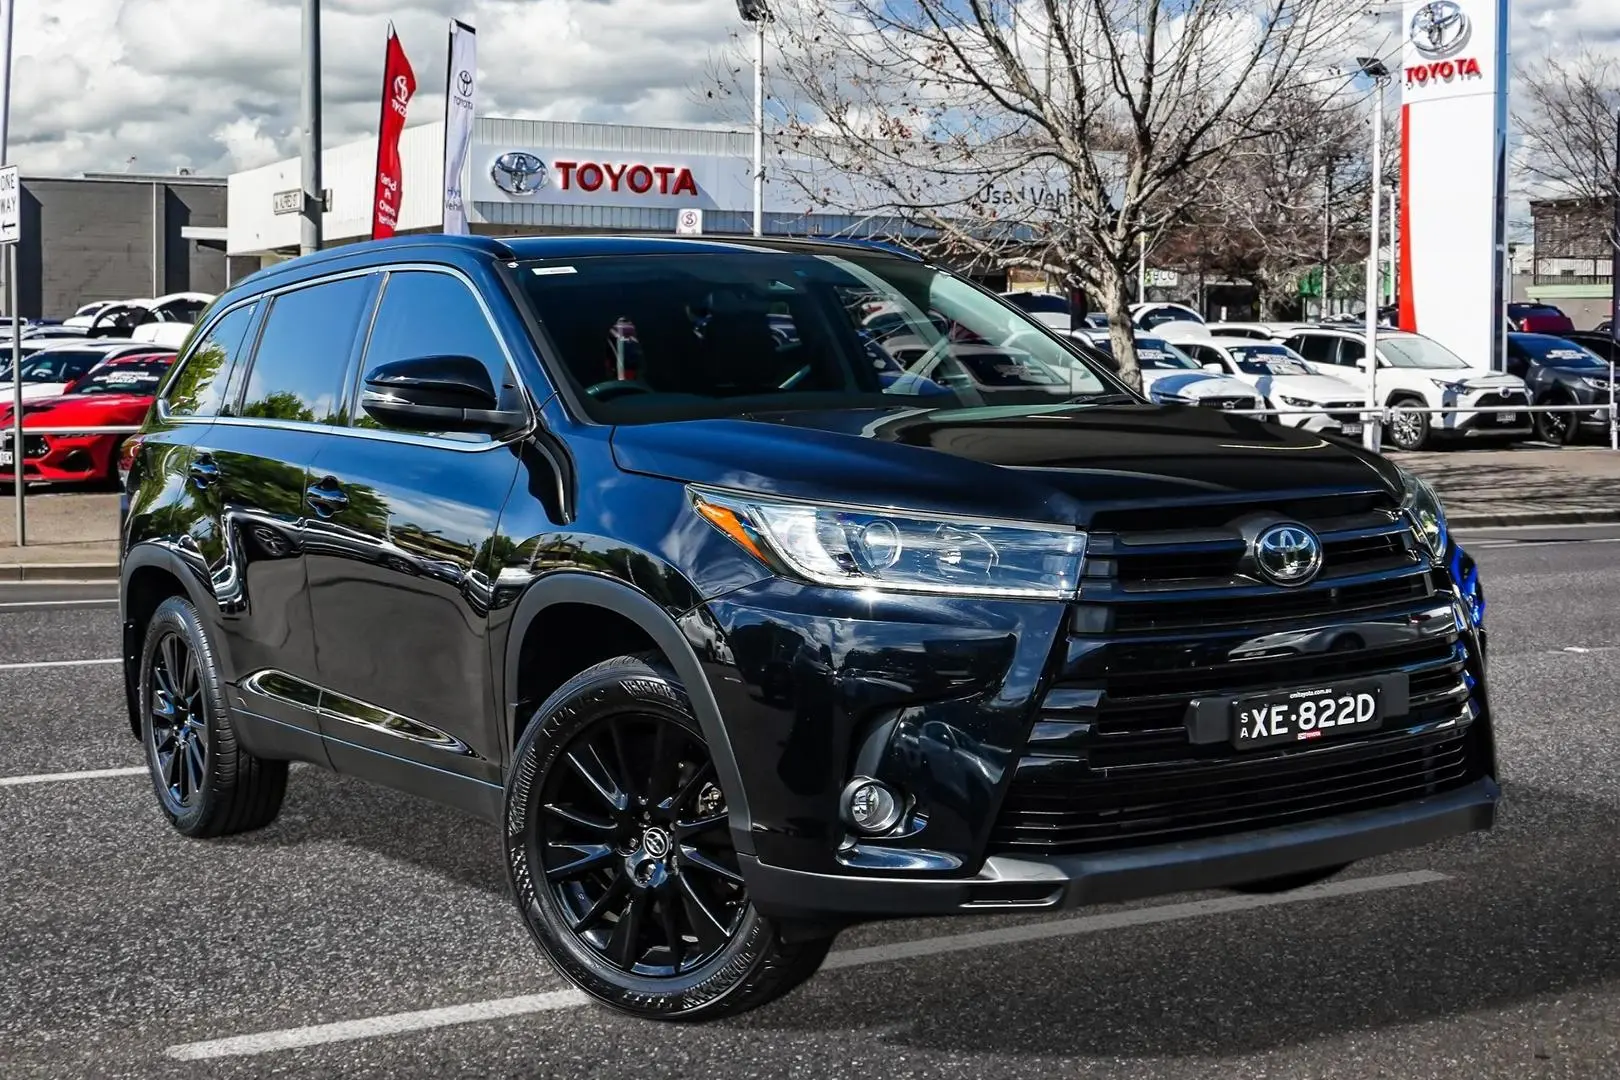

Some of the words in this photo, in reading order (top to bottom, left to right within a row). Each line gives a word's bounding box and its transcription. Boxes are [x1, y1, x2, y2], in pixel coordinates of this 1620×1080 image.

[1404, 58, 1480, 83] TOYOTA
[1, 173, 15, 191] ONE
[555, 161, 698, 196] TOYOTA
[977, 183, 1025, 204] Used
[0, 196, 16, 214] WAY
